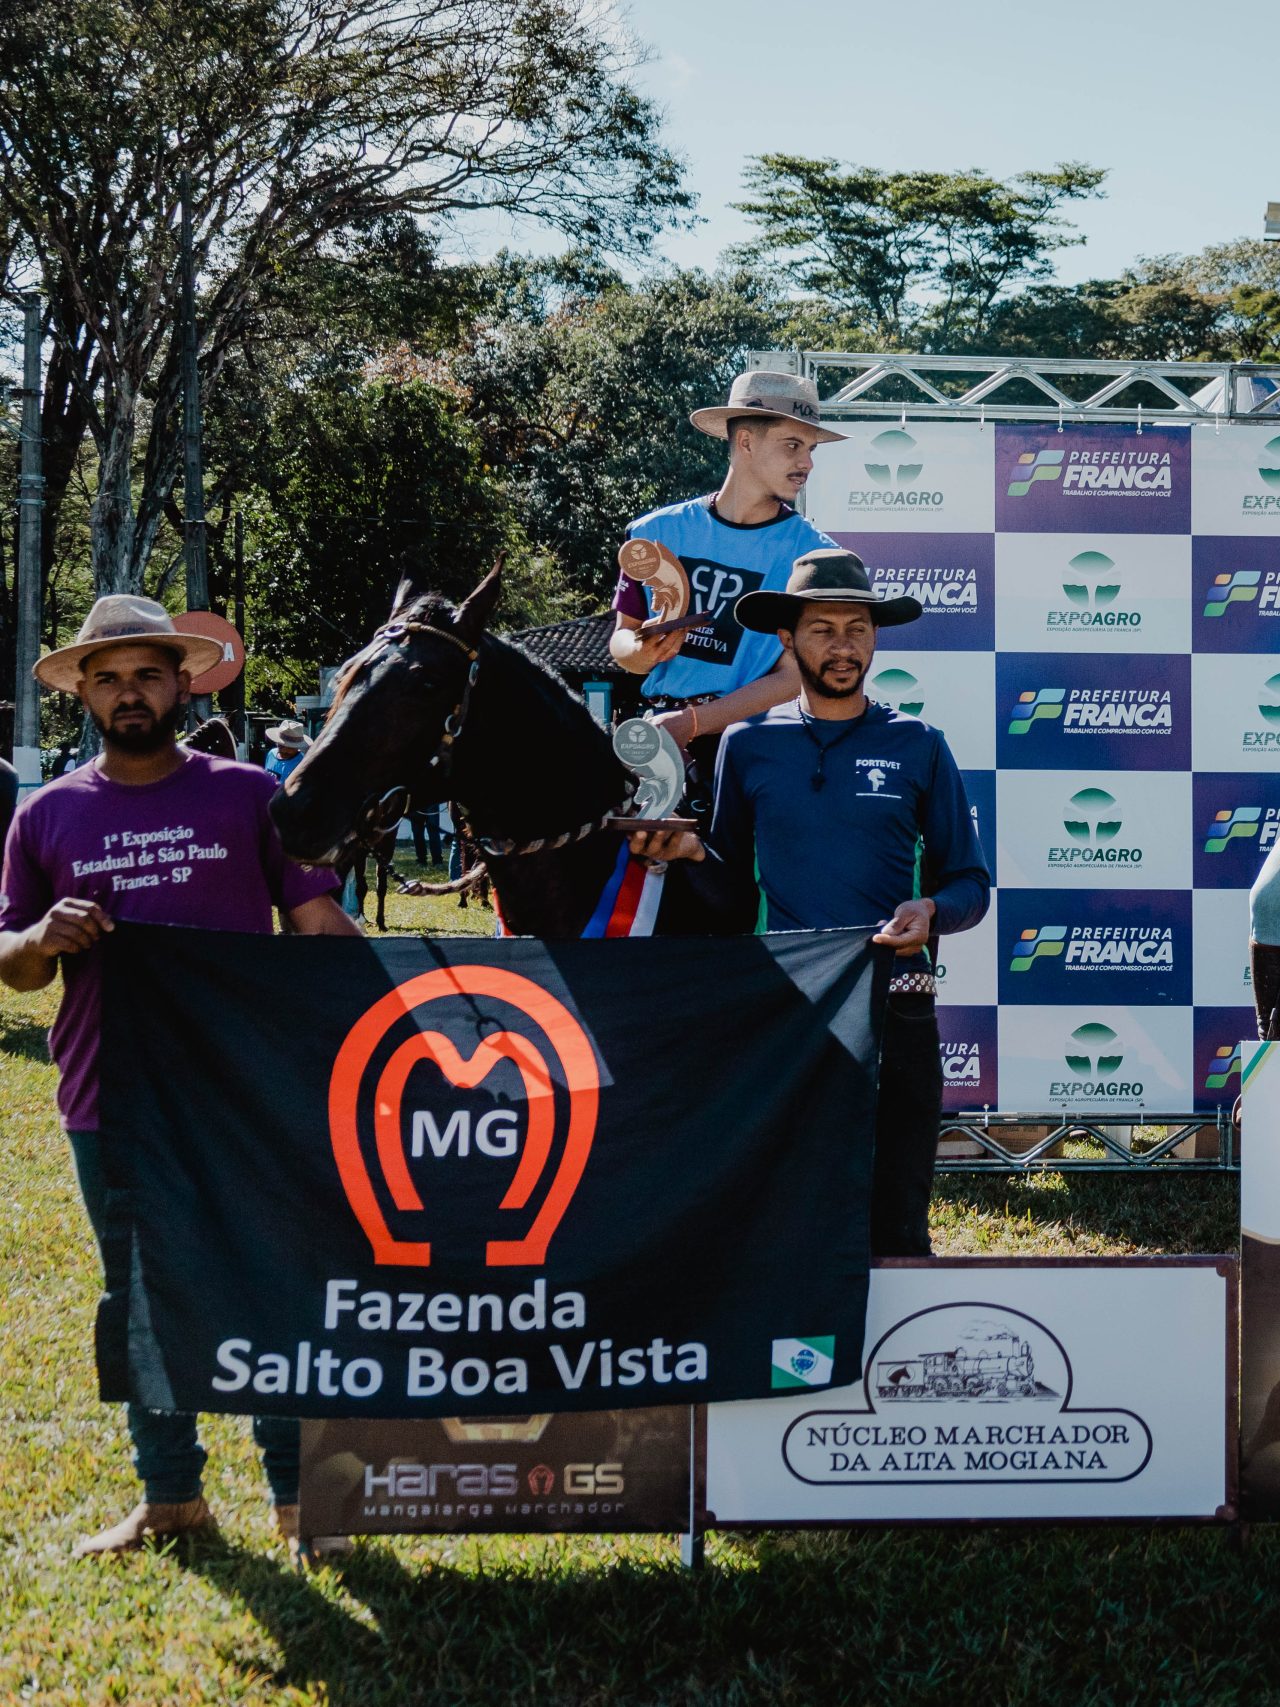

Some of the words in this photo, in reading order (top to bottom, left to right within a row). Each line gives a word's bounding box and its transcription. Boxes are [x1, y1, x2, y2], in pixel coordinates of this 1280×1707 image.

[1069, 451, 1171, 465] PREFEITURA
[1063, 466, 1172, 489] FRANCA
[848, 491, 944, 506] EXPOAGRO
[875, 569, 977, 581] PREFEITURA
[1047, 612, 1142, 626] EXPOAGRO
[684, 632, 728, 652] PITUVA
[1069, 689, 1171, 703] PREFEITURA
[1063, 704, 1172, 727] FRANCA
[856, 759, 901, 770] FORTEVET
[103, 834, 118, 850] 1ª
[121, 825, 194, 848] Exposição
[72, 851, 135, 877] Estadual
[138, 850, 155, 867] de
[158, 847, 185, 863] São
[188, 843, 228, 860] Paulo
[1048, 848, 1143, 862] EXPOAGRO
[112, 874, 160, 892] Franca
[172, 866, 193, 883] SP
[1071, 926, 1172, 939] PREFEITURA
[1065, 941, 1174, 963] FRANCA
[1049, 1082, 1144, 1096] EXPOAGRO
[411, 1109, 519, 1158] MG
[324, 1278, 586, 1332] Fazenda
[212, 1338, 383, 1397] Salto
[407, 1346, 529, 1397] Boa
[549, 1338, 708, 1390] Vista
[806, 1422, 927, 1447] NÚCLEO
[934, 1425, 1130, 1446] MARCHADOR
[830, 1452, 871, 1472] DA
[879, 1452, 956, 1471] ALTA
[964, 1451, 1108, 1470] MOGIANA
[563, 1463, 625, 1495] GS
[506, 1501, 625, 1514] Marchador
